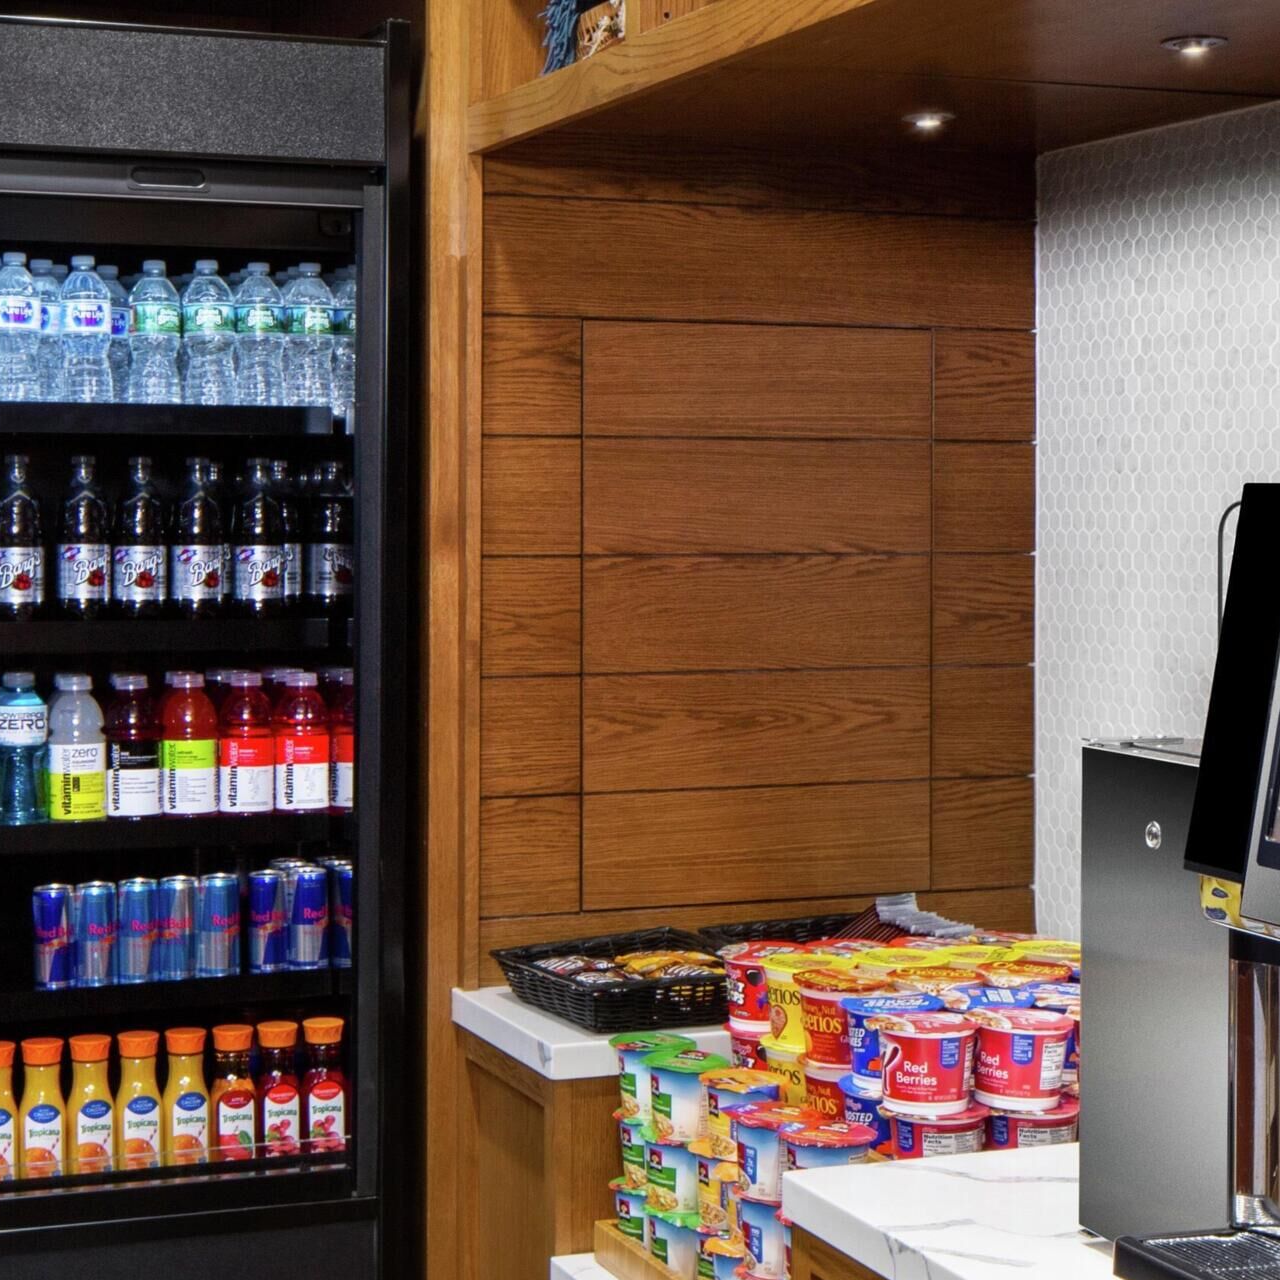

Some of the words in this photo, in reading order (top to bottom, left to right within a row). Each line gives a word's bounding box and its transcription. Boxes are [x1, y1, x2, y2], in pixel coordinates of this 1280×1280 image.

[71, 747, 98, 761] zero
[980, 1051, 1000, 1066] Red
[904, 1061, 928, 1074] Red
[896, 1071, 938, 1086] Berries
[268, 1109, 298, 1120] Tropicana
[312, 1106, 342, 1117] Tropicana
[128, 1118, 159, 1129] Tropicana
[177, 1116, 207, 1127] Tropicana
[223, 1114, 253, 1125] Tropicana
[30, 1127, 60, 1138] Tropicana
[82, 1123, 112, 1134] Tropicana
